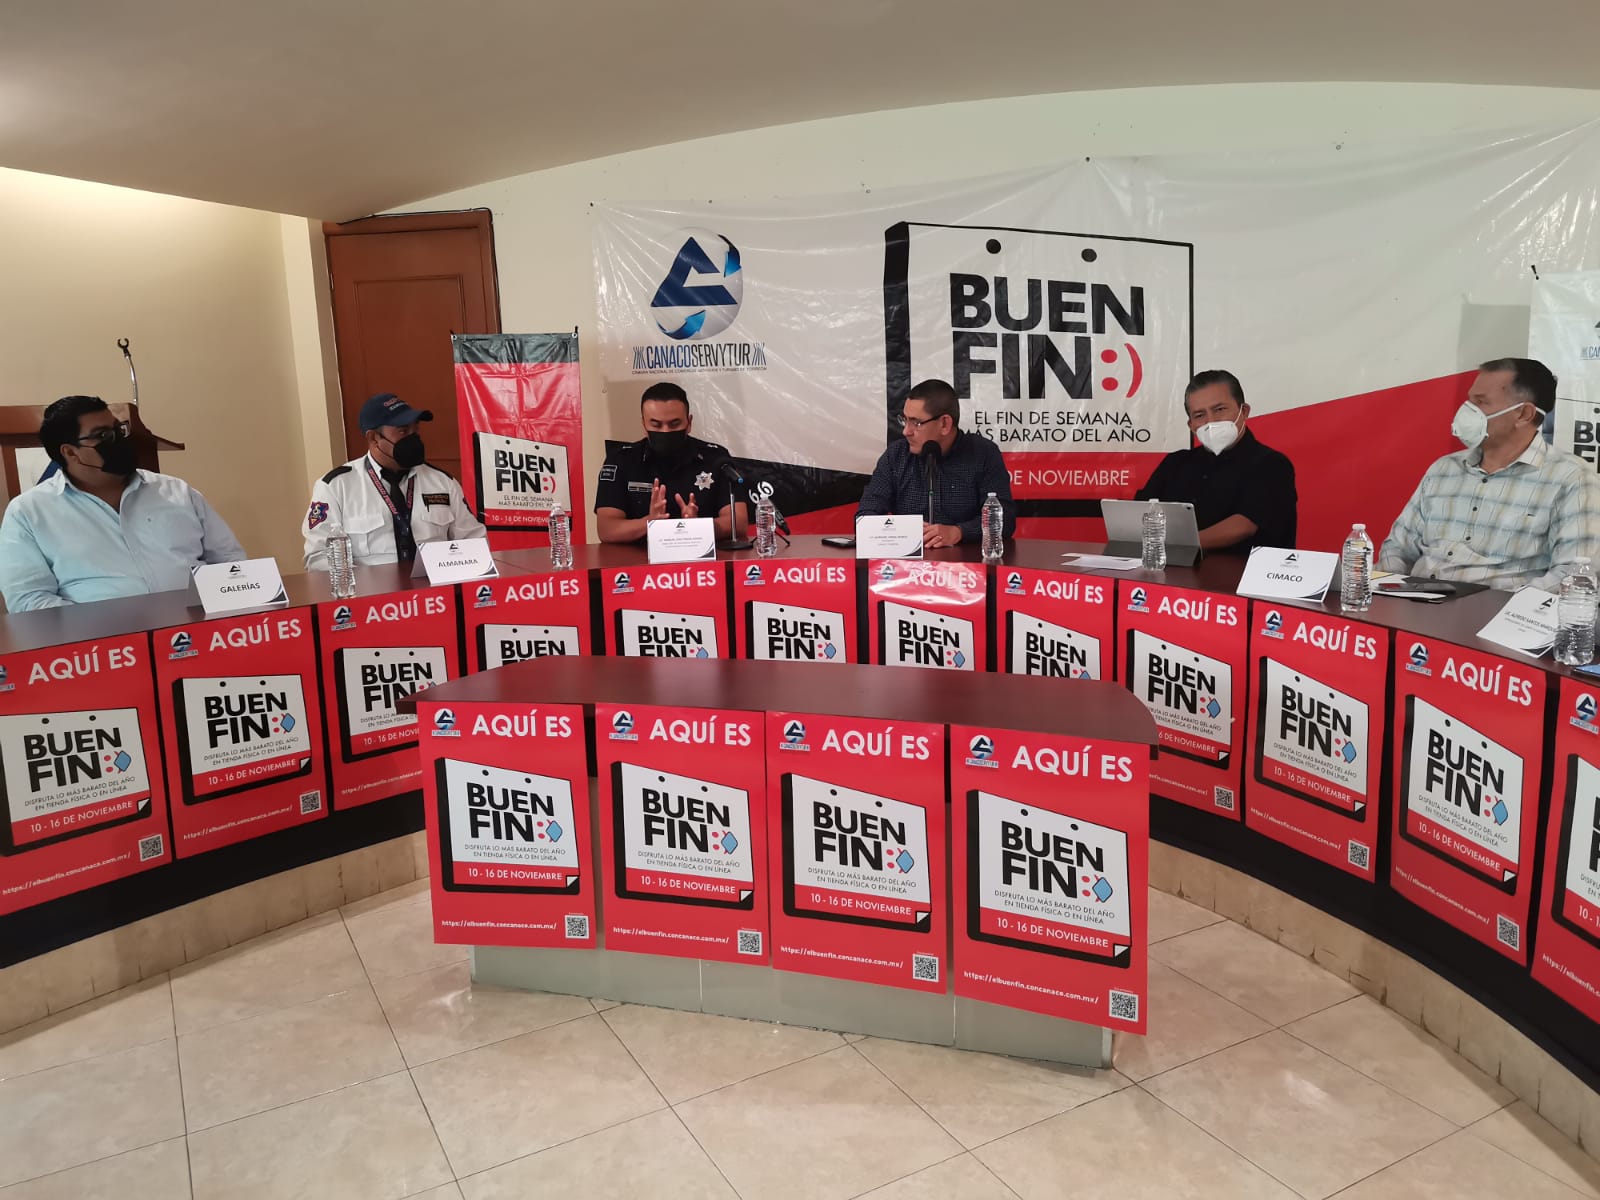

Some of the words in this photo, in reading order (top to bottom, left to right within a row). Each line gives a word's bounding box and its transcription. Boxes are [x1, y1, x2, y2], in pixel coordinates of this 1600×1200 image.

[950, 272, 1144, 336] BUEN
[646, 343, 750, 369] CANACOSERVYTUR
[975, 411, 991, 425] EL
[996, 411, 1023, 425] FIN
[1029, 411, 1050, 425] DE
[1056, 411, 1132, 426] SEMANA
[1000, 428, 1066, 443] BARATO
[1072, 428, 1102, 443] DEL
[1107, 425, 1151, 443] AÑO
[494, 449, 556, 474] BUEN
[1028, 469, 1130, 486] NOVIEMBRE
[438, 558, 478, 568] ALMANARA
[773, 562, 823, 584] AQUÍ
[827, 567, 846, 583] ES
[906, 563, 954, 588] AQUÍ
[958, 572, 977, 589] ES
[219, 581, 261, 594] GALERÍAS
[505, 576, 554, 603] AQUÍ
[560, 578, 580, 598] ES
[642, 567, 693, 591] AQUÍ
[696, 570, 717, 587] ES
[1033, 577, 1080, 602] AQUÍ
[1085, 585, 1104, 605] ES
[1266, 572, 1303, 583] CIMACO
[365, 593, 418, 624] AQUÍ
[424, 595, 445, 614] ES
[1157, 595, 1211, 621] AQUÍ
[1216, 604, 1238, 626] ES
[208, 616, 270, 651] AQUÍ
[277, 617, 301, 639] ES
[637, 625, 703, 646] BUEN
[767, 618, 831, 641] BUEN
[898, 619, 960, 648] BUEN
[1292, 621, 1350, 653] AQUÍ
[1354, 634, 1377, 661] ES
[500, 639, 565, 659] BUEN
[1026, 631, 1087, 667] BUEN
[27, 644, 100, 685] AQUÍ
[108, 645, 136, 669] ES
[360, 662, 432, 685] BUEN
[1148, 652, 1215, 695] BUEN
[1440, 656, 1503, 696] AQUÍ
[1508, 674, 1533, 707] ES
[203, 692, 287, 719] BUEN
[1281, 683, 1351, 737] BUEN
[472, 709, 538, 738] AQUÍ
[545, 715, 572, 738] ES
[649, 715, 717, 744] AQUÍ
[724, 722, 751, 746] ES
[23, 727, 122, 760] BUEN
[821, 727, 893, 756] AQUÍ
[901, 734, 930, 760] ES
[1164, 732, 1173, 741] DE
[1174, 735, 1216, 753] NOVIEMBRE
[207, 775, 218, 785] 10
[224, 772, 234, 781] 16
[235, 769, 247, 779] DE
[248, 758, 296, 776] NOVIEMBRE
[1011, 745, 1092, 777] AQUÍ
[1101, 754, 1133, 782] ES
[1427, 727, 1503, 795] BUEN
[1273, 765, 1282, 776] 10
[1287, 770, 1295, 781] 16
[1296, 774, 1305, 785] DE
[1307, 778, 1351, 803] NOVIEMBRE
[466, 781, 554, 816] BUEN
[641, 787, 730, 827] BUEN
[29, 822, 41, 834] 10
[49, 817, 60, 829] 16
[62, 814, 75, 825] DE
[77, 799, 133, 821] NOVIEMBRE
[812, 800, 906, 845] BUEN
[1001, 820, 1103, 872] BUEN
[1418, 820, 1427, 834] 10
[1432, 828, 1441, 841] 16
[1442, 833, 1452, 847] DE
[1453, 839, 1501, 872] NOVIEMBRE
[467, 867, 478, 877] 10
[485, 868, 495, 878] 16
[496, 869, 508, 878] DE
[510, 870, 562, 880] NOVIEMBRE
[640, 875, 650, 885] 10
[658, 877, 667, 887] 16
[669, 879, 681, 888] DE
[683, 880, 736, 893] NOVIEMBRE
[807, 867, 835, 876] DISFRUTA
[846, 871, 860, 880] MÁS
[862, 874, 886, 883] BARATO
[900, 879, 916, 888] AÑO
[827, 877, 848, 885] TIENDA
[850, 879, 869, 888] FÍSICA
[888, 884, 906, 894] LÍNEA
[810, 892, 820, 903] 10
[828, 895, 838, 906] 16
[840, 897, 852, 908] DE
[855, 899, 911, 915] NOVIEMBRE
[994, 889, 1024, 901] DISFRUTA
[1026, 895, 1034, 903] LO
[1036, 897, 1052, 906] MÁS
[1054, 901, 1081, 912] BARATO
[1083, 906, 1095, 915] DEL
[1097, 909, 1115, 919] AÑO
[1004, 899, 1013, 907] EN
[1015, 901, 1039, 911] TIENDA
[1040, 906, 1061, 916] FÍSICA
[1072, 912, 1082, 920] EN
[1083, 914, 1104, 924] LÍNEA
[996, 916, 1008, 928] 10
[1016, 921, 1027, 932] 16
[1030, 924, 1043, 936] DE
[1046, 927, 1109, 948] NOVIEMBRE
